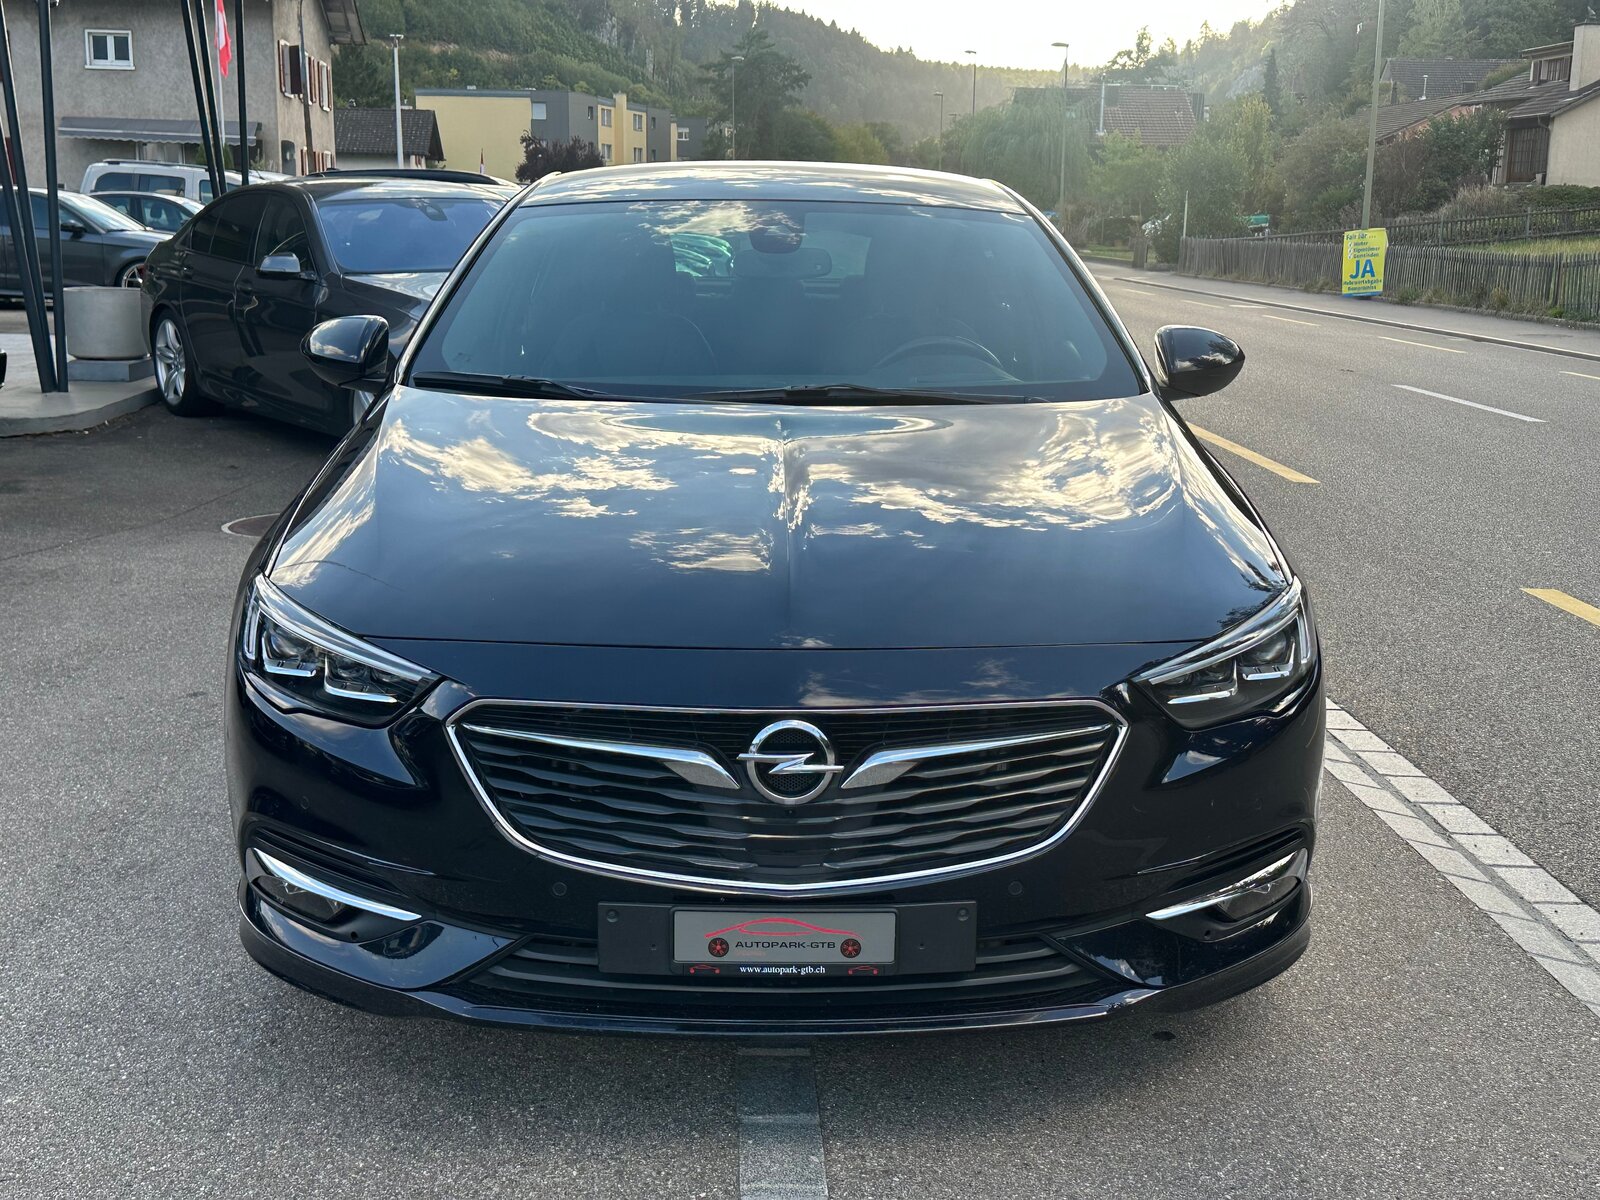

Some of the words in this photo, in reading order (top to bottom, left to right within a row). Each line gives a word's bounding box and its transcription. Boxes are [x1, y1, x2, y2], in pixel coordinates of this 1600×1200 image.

[1349, 259, 1375, 279] JA
[735, 941, 836, 949] AUTOPARK-GTB
[739, 965, 826, 976] www.autopark-gtb.ch
